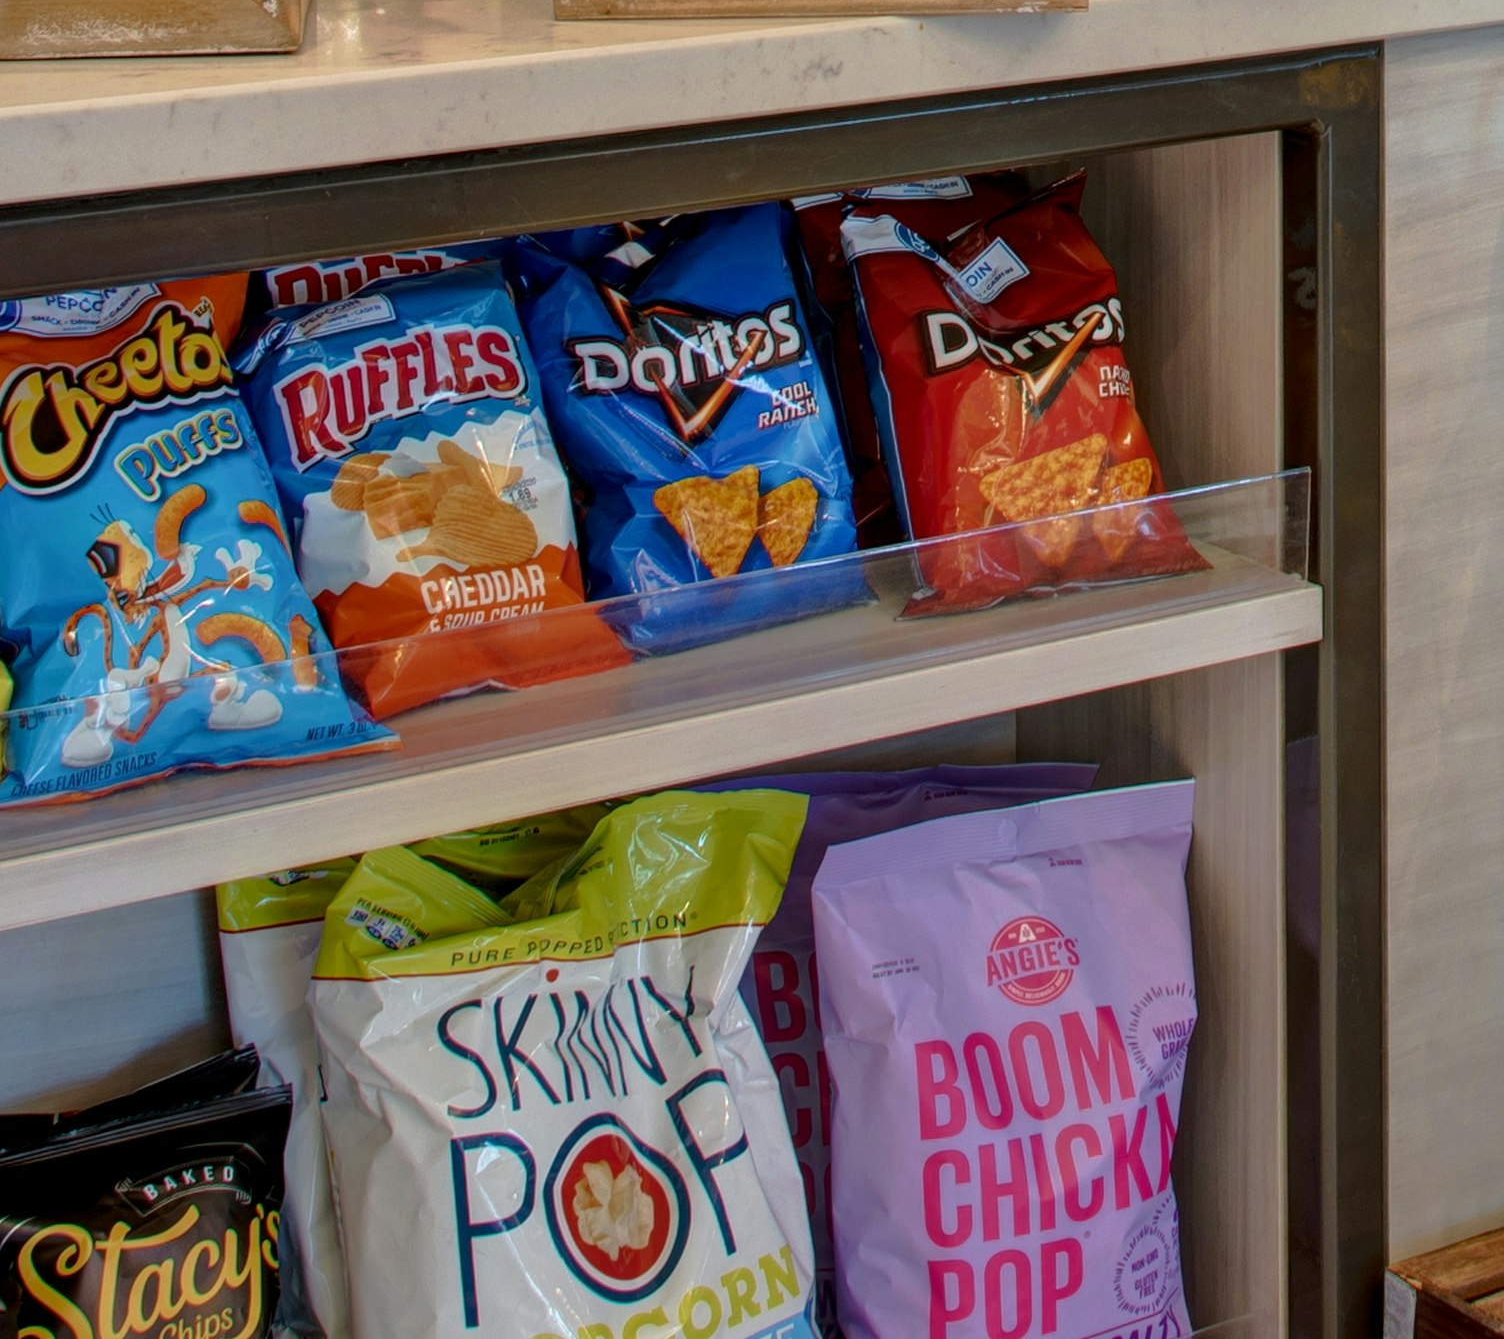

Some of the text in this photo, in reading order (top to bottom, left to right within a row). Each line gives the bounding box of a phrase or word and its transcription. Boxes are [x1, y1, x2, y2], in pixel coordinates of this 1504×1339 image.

[574, 304, 802, 394] Doritos
[926, 297, 1124, 370] Doritos
[282, 330, 522, 466] RUFFLES
[757, 397, 820, 430] RANCH
[770, 381, 812, 407] COOL
[421, 563, 547, 615] CHEDDAR
[306, 725, 326, 743] NET
[11, 752, 158, 797] CHEESE FLAVORED SNACKS
[451, 936, 604, 967] PURE POPPED
[986, 938, 1081, 987] ANGIE'S
[437, 968, 706, 1118] SKINNY
[914, 1005, 1136, 1140] BOOM
[142, 1164, 236, 1202] BAKED
[450, 1069, 749, 1329] POP
[18, 1203, 280, 1339] Stacy's
[927, 1240, 1084, 1339] POP
[1135, 1270, 1158, 1290] GLUTEN
[1139, 1284, 1155, 1299] FREE
